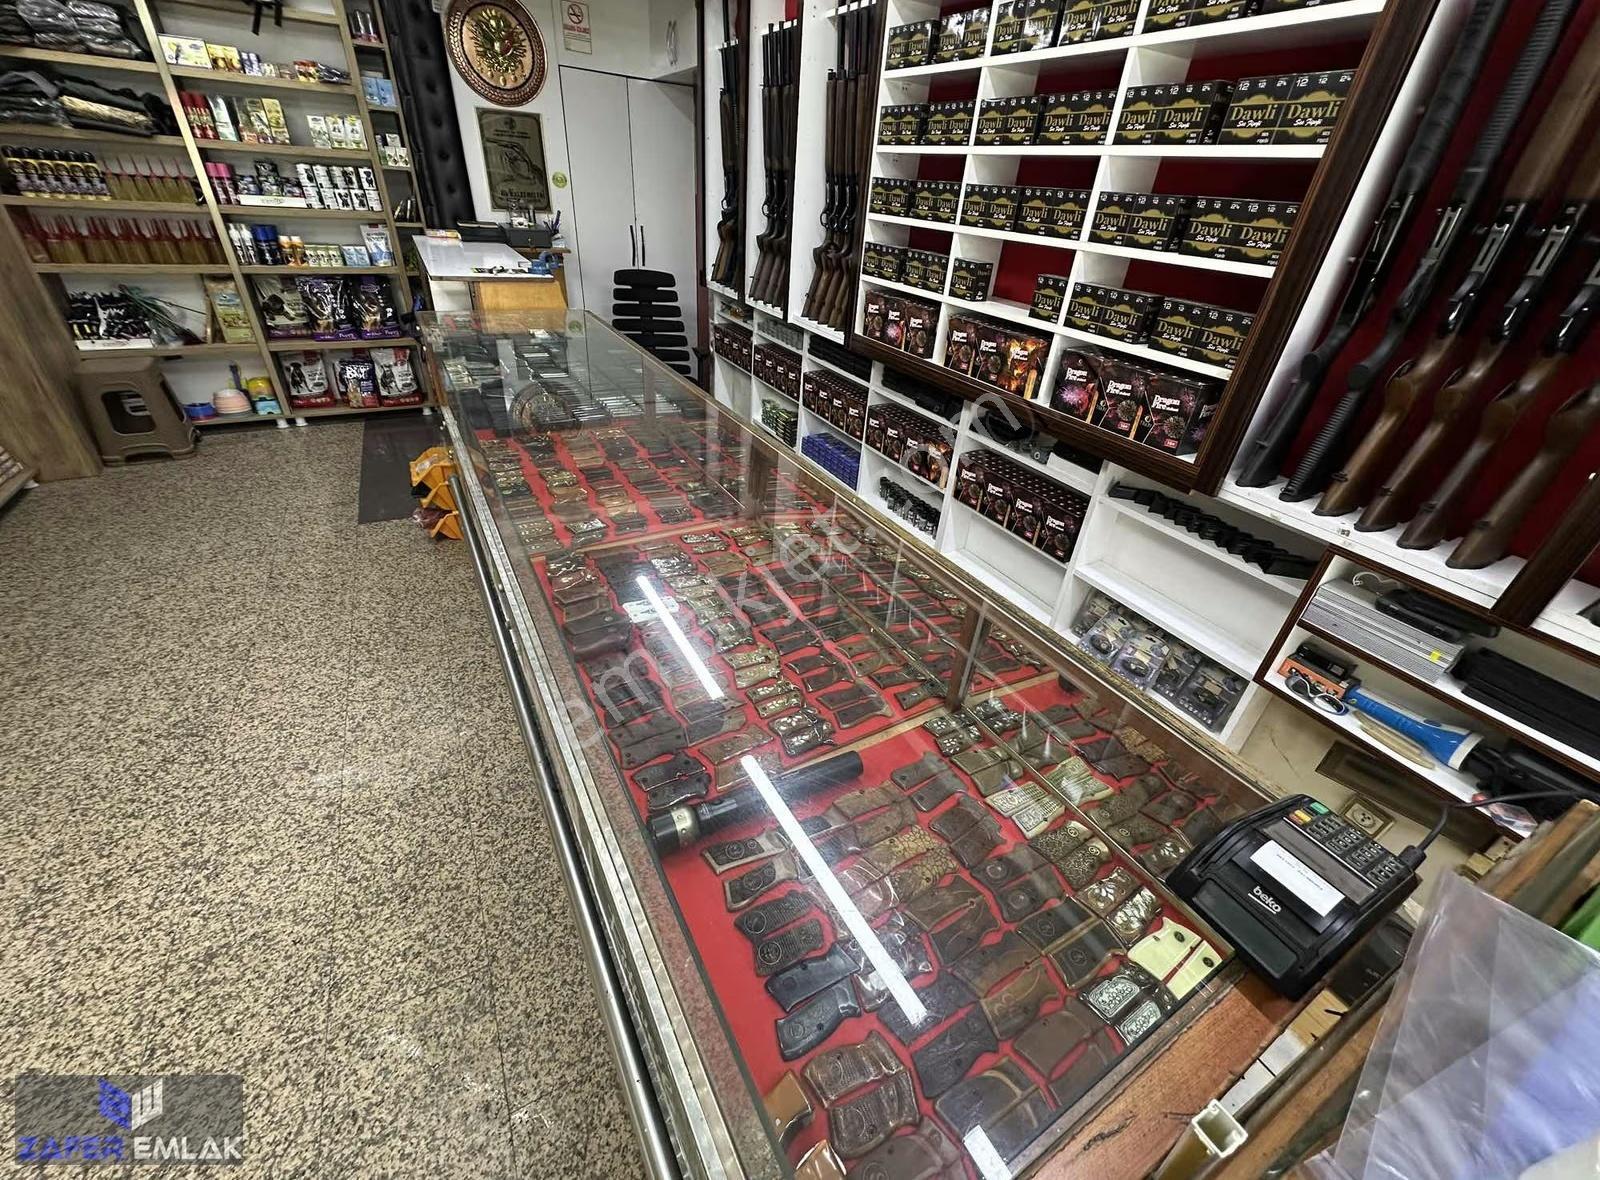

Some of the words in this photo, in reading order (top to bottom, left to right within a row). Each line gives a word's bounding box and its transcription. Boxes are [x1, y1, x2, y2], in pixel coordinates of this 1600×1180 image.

[1065, 8, 1096, 26] Dawli
[1104, 1, 1138, 19] Dawli
[995, 22, 1020, 37] Dawli
[1239, 82, 1250, 91] 12
[1296, 78, 1309, 87] 12
[1169, 86, 1179, 95] 12
[1121, 108, 1156, 124] Dawli
[1162, 107, 1203, 123] Dawli
[1230, 104, 1277, 121] Dawli
[1287, 101, 1341, 120] Dawli
[949, 118, 970, 130] Dawli
[978, 117, 1004, 129] Dawli
[1007, 115, 1033, 128] Dawli
[1045, 114, 1074, 127] Dawli
[1079, 112, 1111, 126] Dawli
[937, 198, 956, 210] Dawli
[964, 201, 985, 212] Dawli
[990, 203, 1013, 216] Dawli
[1196, 200, 1205, 208] 12
[1248, 204, 1258, 213] 12
[1022, 205, 1048, 219] Dawli
[1054, 208, 1081, 223] Dawli
[1096, 213, 1127, 228] Dawli
[1133, 216, 1168, 232] Dawli
[1190, 221, 1233, 238] Dawli
[1239, 226, 1288, 244] Dawli
[952, 273, 973, 287] Dawli
[1034, 293, 1061, 308] Dawli
[1070, 300, 1100, 317] Dawli
[1208, 311, 1218, 320] 12
[1105, 308, 1138, 326] Dawli
[1157, 320, 1193, 339] Dawli
[1202, 330, 1244, 350] Dawli
[1253, 885, 1282, 913] beko
